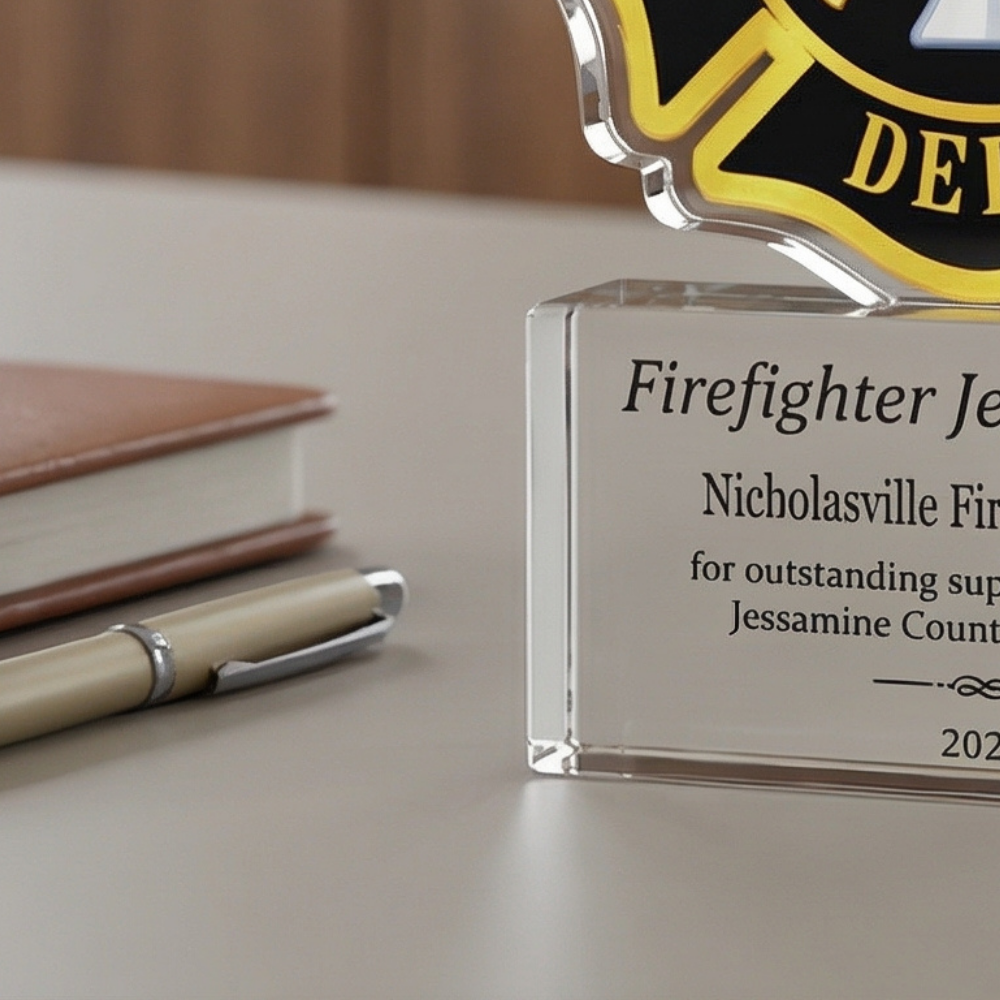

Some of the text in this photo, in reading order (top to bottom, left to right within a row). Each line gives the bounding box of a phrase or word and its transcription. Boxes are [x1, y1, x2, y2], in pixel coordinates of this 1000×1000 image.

[621, 358, 938, 436] Firefighter
[701, 471, 939, 528] Nicholasville
[690, 550, 736, 582] for
[744, 560, 939, 603] outstanding
[728, 599, 892, 638] Jessamine
